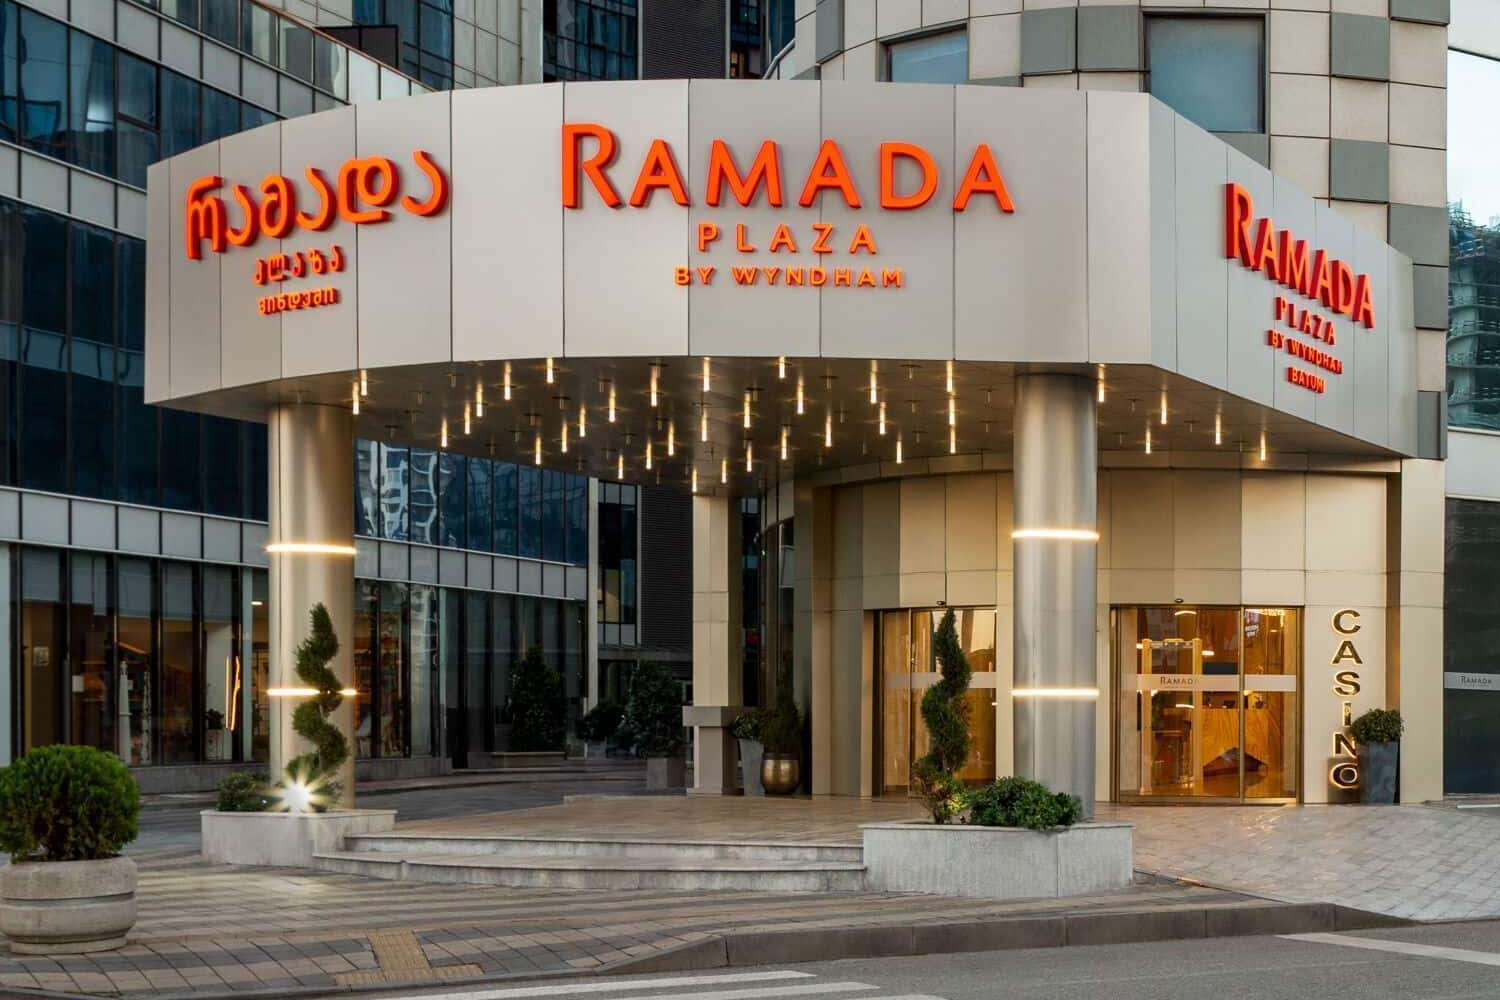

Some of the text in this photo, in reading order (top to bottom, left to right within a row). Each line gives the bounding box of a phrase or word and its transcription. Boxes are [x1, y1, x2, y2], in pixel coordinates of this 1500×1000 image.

[562, 122, 1015, 214] RAMADA
[184, 151, 450, 261] რამადა
[697, 222, 877, 255] PLAZA
[674, 266, 903, 289] BY WYNDHAM
[1225, 184, 1375, 329] RAMADA
[1267, 330, 1285, 349] BY
[1275, 296, 1336, 345] PLAZA
[1331, 608, 1363, 789] CASINO
